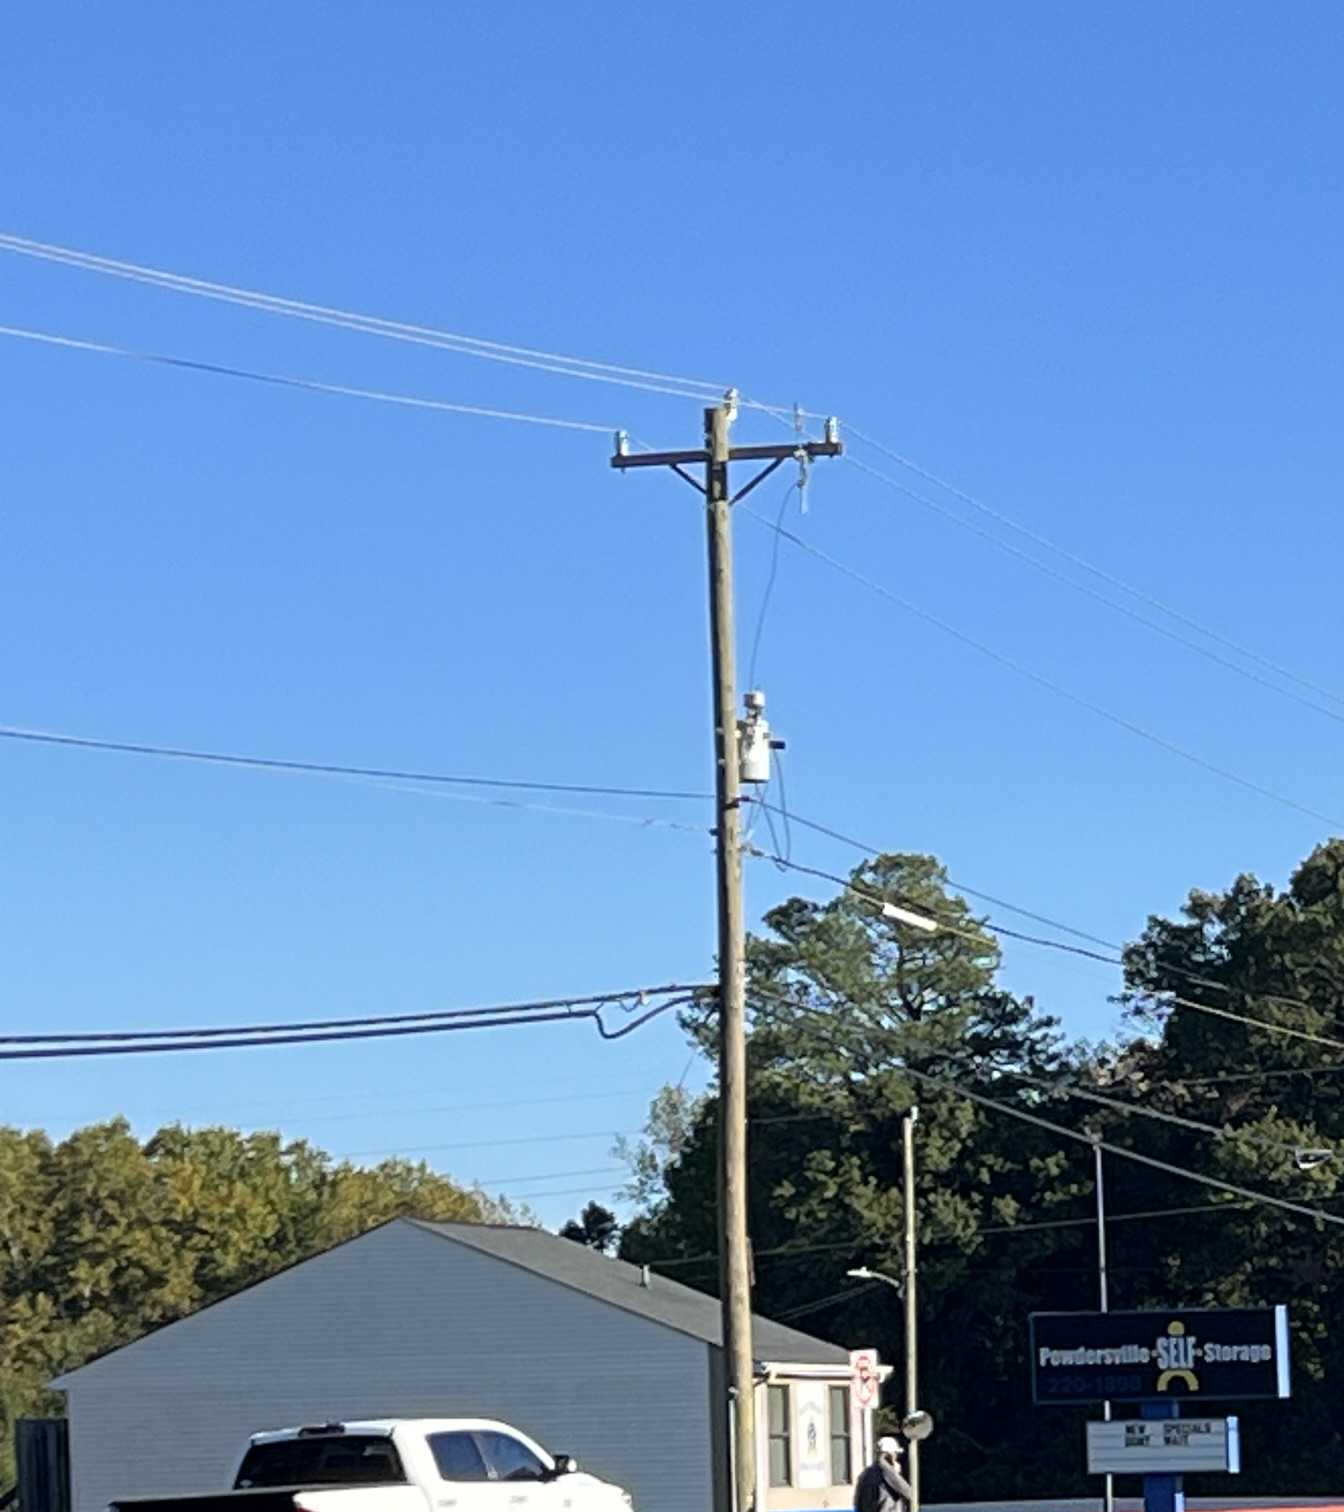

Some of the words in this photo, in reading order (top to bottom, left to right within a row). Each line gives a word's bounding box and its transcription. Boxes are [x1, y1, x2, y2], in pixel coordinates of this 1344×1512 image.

[1040, 1345, 1150, 1366] Powdersville
[1156, 1336, 1197, 1369] SELF
[1204, 1342, 1272, 1363] Storage
